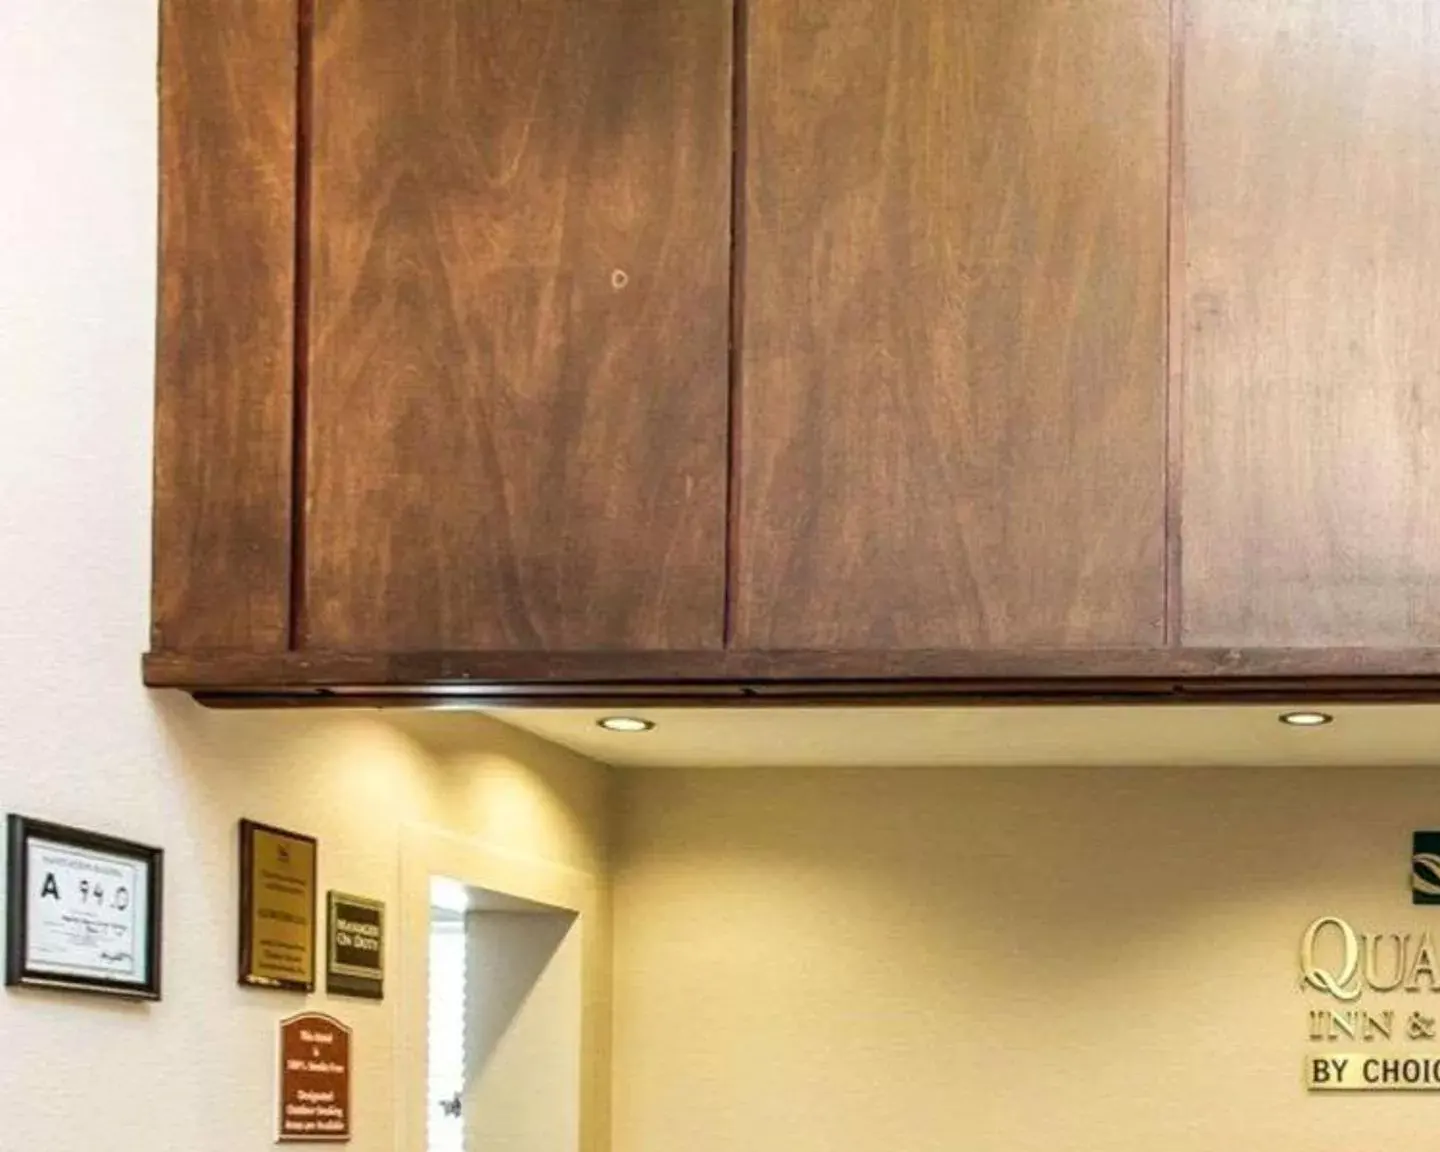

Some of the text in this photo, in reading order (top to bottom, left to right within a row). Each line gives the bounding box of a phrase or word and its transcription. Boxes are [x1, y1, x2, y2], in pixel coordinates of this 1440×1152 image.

[41, 872, 60, 900] A
[1309, 1009, 1394, 1042] INN
[1407, 1010, 1436, 1041] &
[1313, 1058, 1349, 1083] BY
